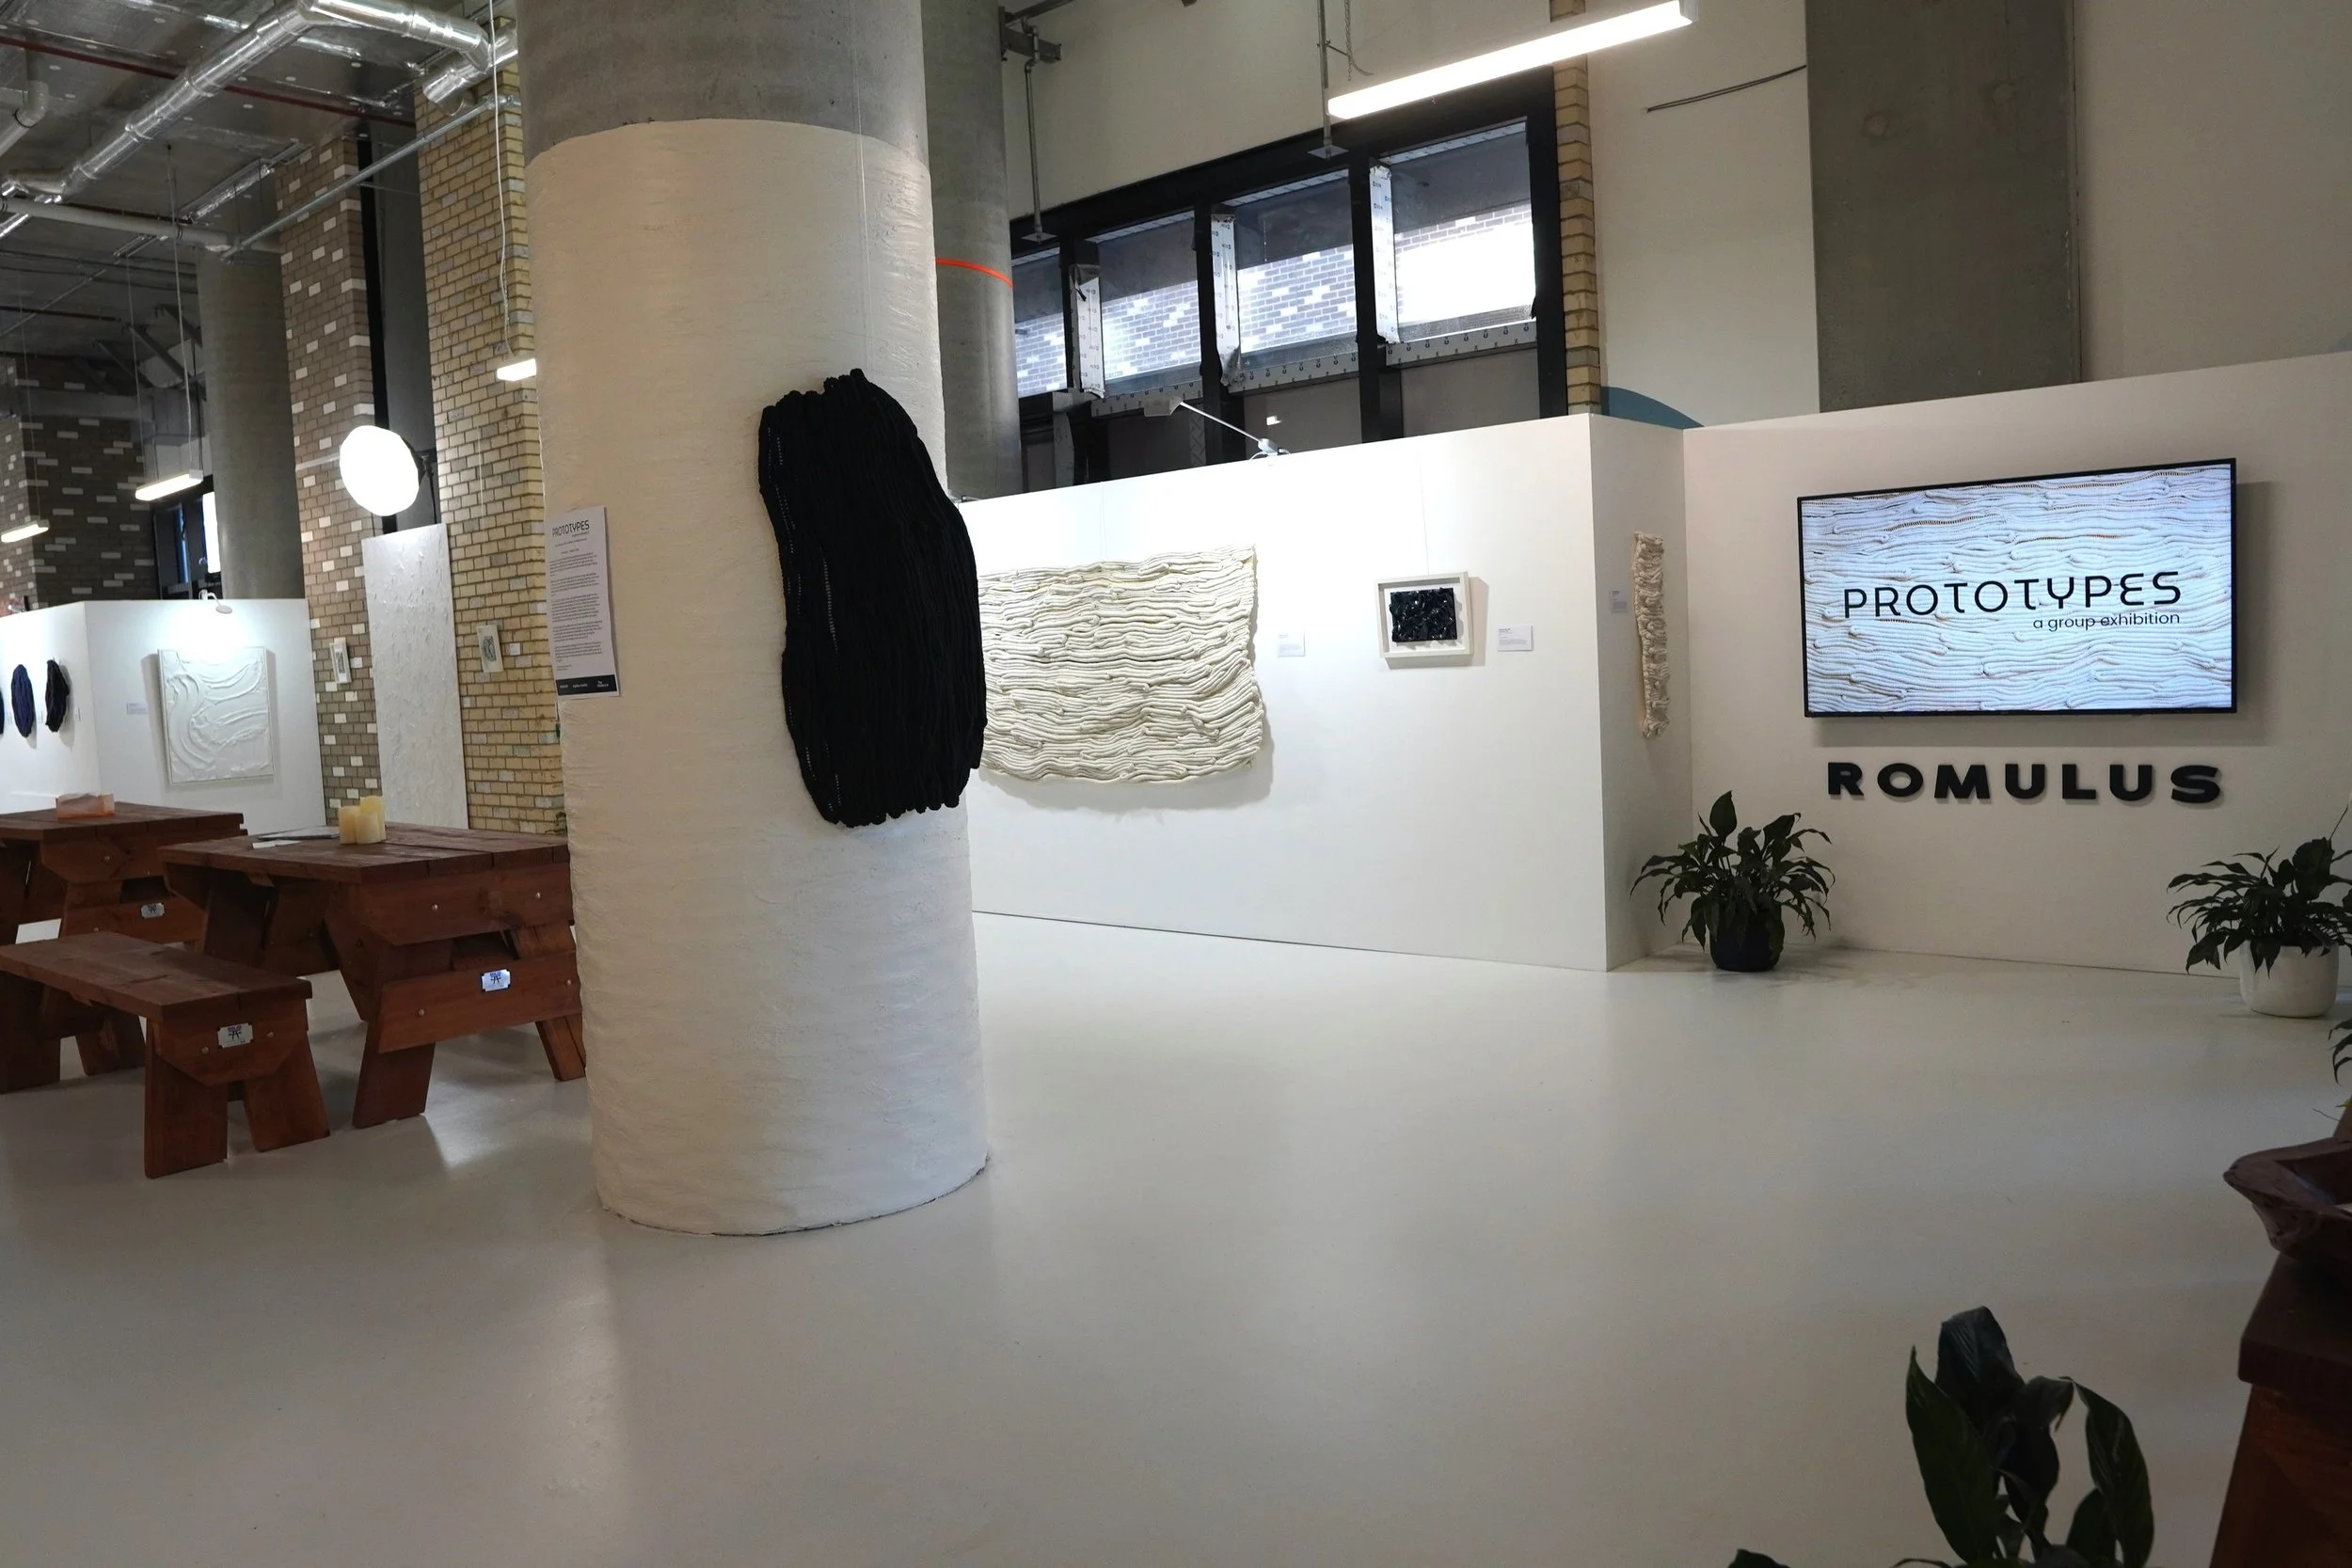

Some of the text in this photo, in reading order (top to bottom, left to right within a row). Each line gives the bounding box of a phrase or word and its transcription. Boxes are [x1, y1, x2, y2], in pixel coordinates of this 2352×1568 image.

[552, 519, 590, 537] PROTOTYPES
[1844, 571, 2181, 619] PROTOTYPES
[2033, 612, 2181, 632] a group exhibition
[1827, 762, 2222, 806] ROMULUS
